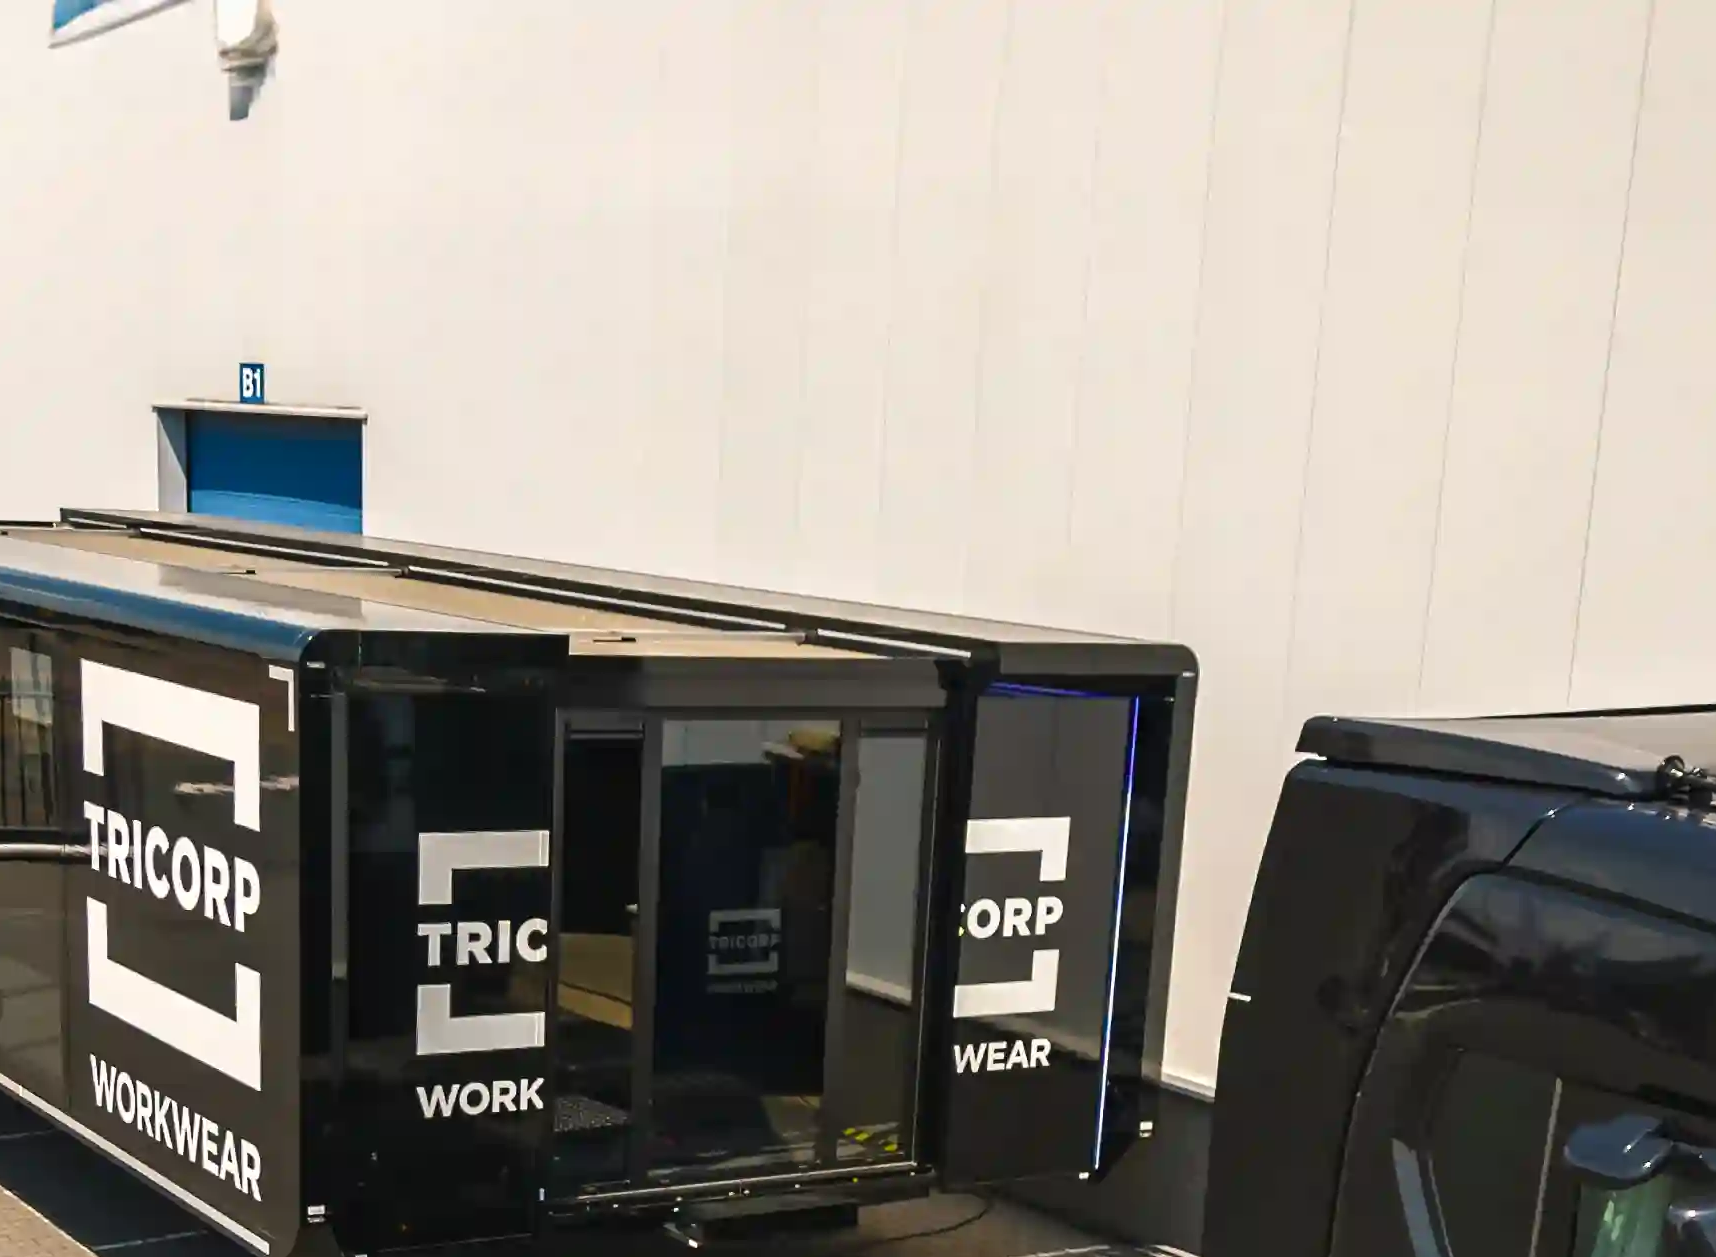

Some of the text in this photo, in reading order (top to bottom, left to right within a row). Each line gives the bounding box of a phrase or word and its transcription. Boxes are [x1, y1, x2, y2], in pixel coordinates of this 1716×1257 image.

[242, 367, 261, 398] B1
[83, 800, 262, 933] TRICORP
[958, 896, 1065, 939] ORP
[416, 917, 549, 968] TRIC
[952, 1037, 1053, 1075] WEAR
[415, 1077, 546, 1119] WORK
[88, 1052, 263, 1203] WORKWEAR
